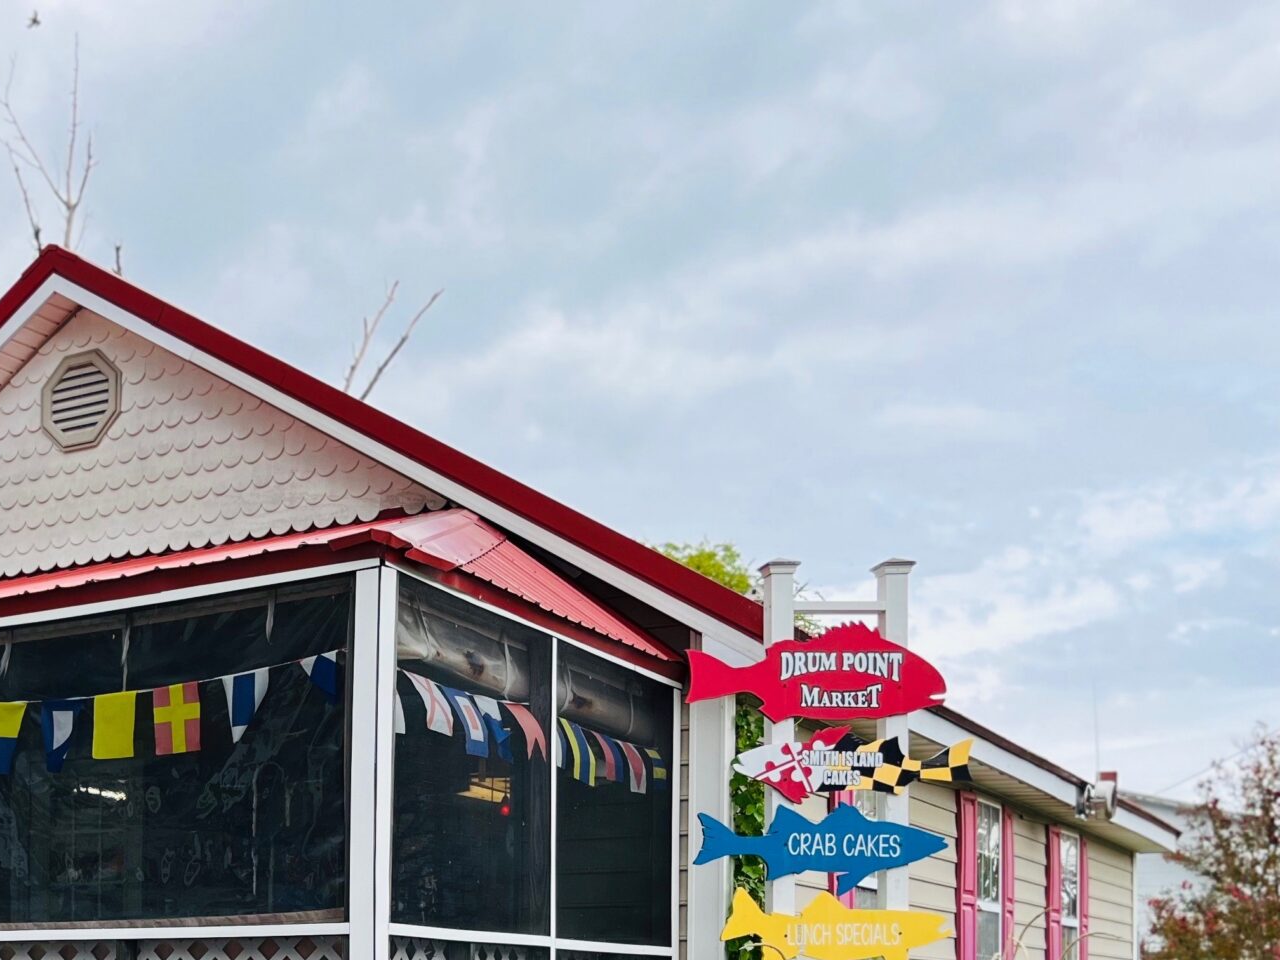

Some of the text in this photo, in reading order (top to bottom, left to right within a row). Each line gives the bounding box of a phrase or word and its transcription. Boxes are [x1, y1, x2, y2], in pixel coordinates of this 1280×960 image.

[780, 651, 903, 682] DRUM POINT
[800, 684, 882, 709] MARKET
[802, 749, 884, 769] SMITH ISLAND
[823, 769, 861, 786] CAKES
[788, 833, 901, 858] CRAB CAKES
[787, 923, 901, 946] LUNCH SPECIALS
